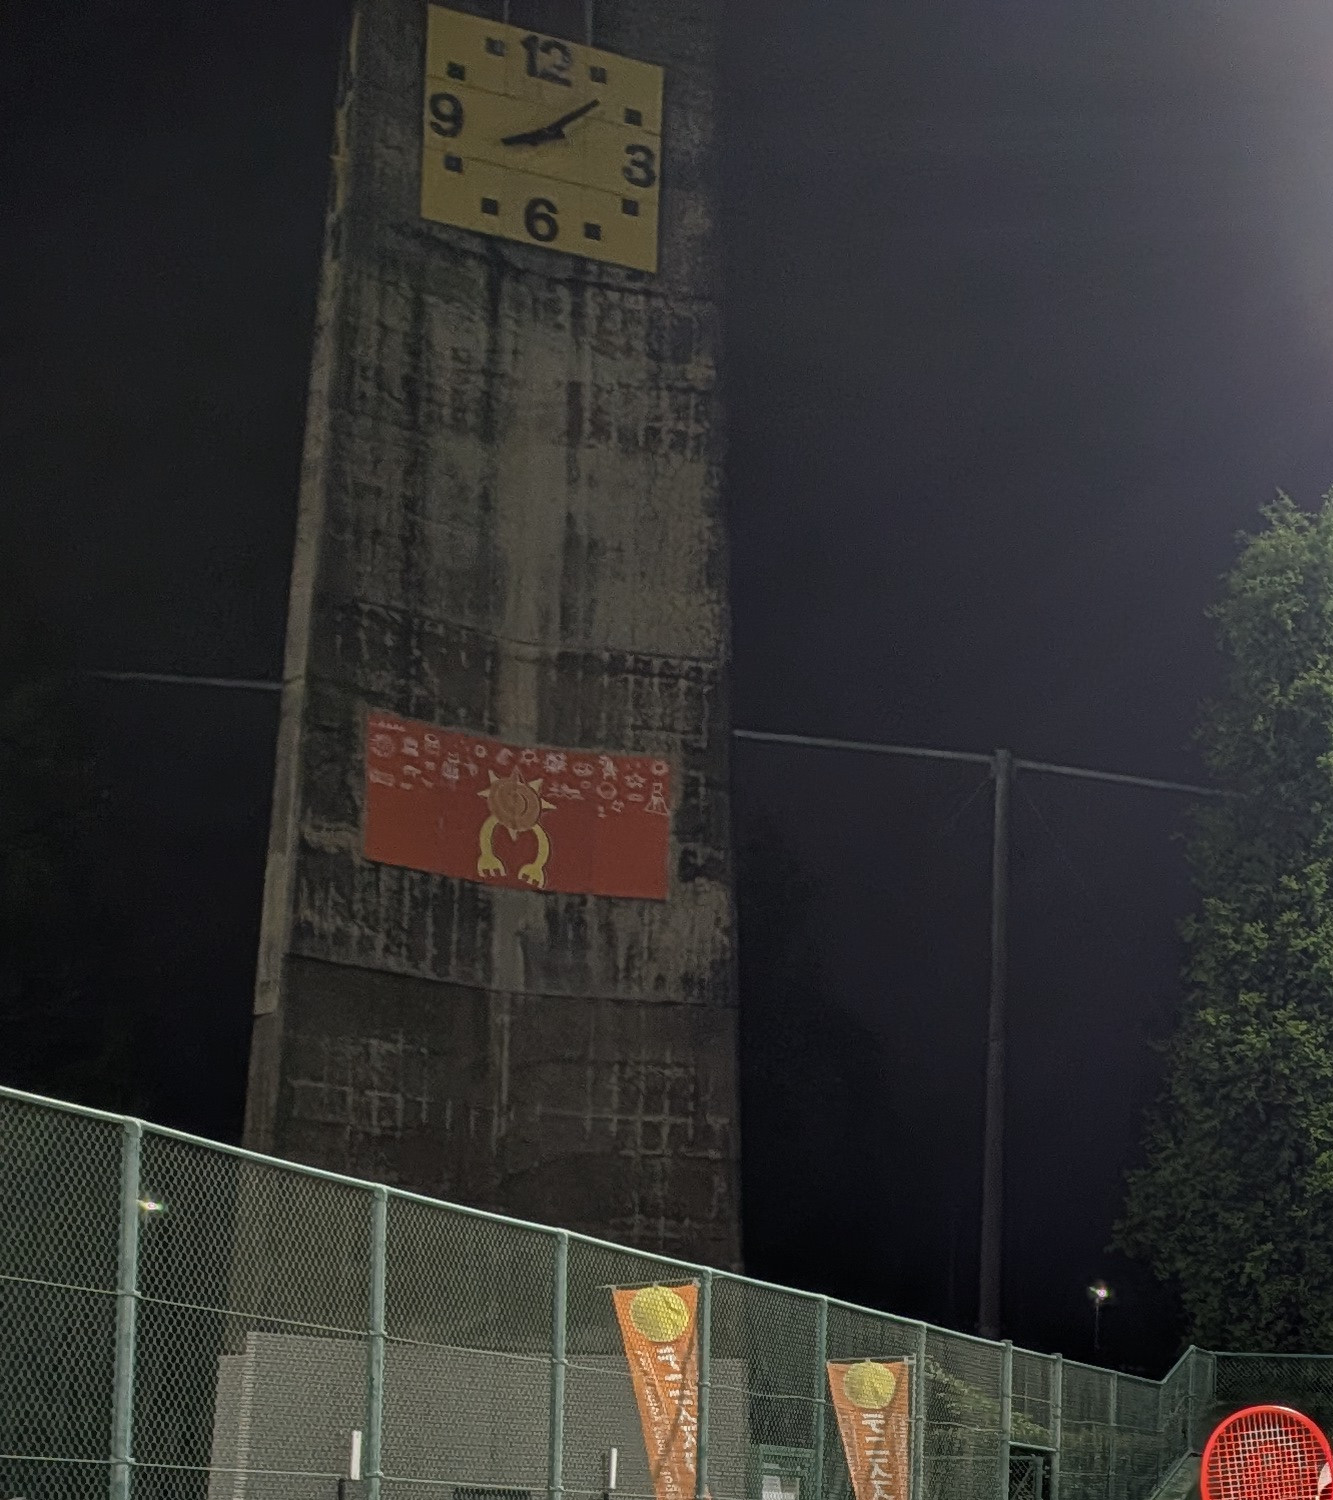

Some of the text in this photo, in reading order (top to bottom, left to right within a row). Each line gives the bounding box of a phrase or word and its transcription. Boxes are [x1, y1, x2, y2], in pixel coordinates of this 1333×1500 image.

[521, 34, 573, 88] 12
[428, 92, 464, 138] 9
[622, 144, 657, 188] 3
[524, 197, 559, 243] 6
